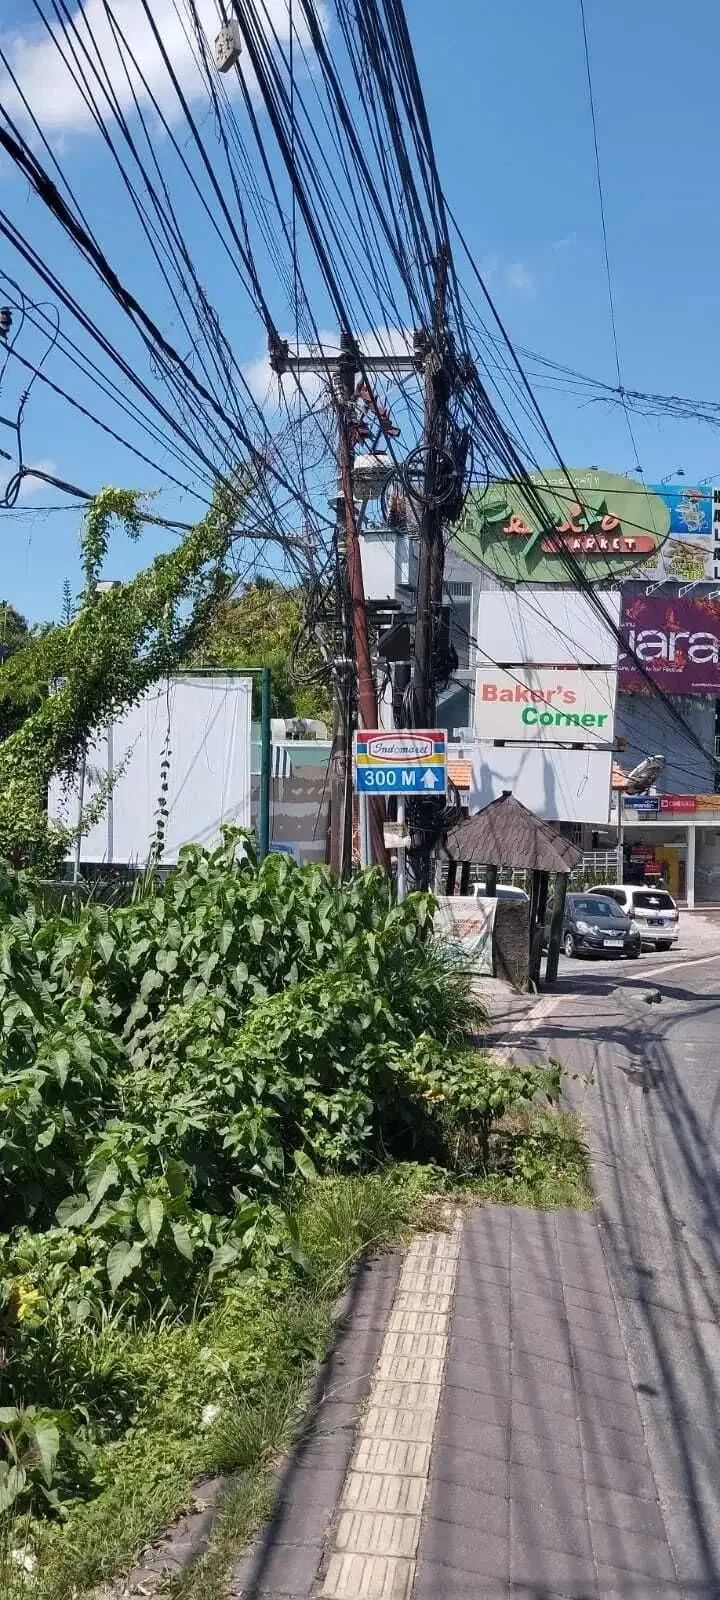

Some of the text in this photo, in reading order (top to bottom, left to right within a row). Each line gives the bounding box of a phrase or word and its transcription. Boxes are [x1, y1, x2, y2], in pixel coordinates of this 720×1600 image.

[481, 683, 577, 705] Baker's
[521, 706, 609, 728] Corner
[372, 743, 429, 754] Indomaret
[364, 770, 416, 786] 300 M
